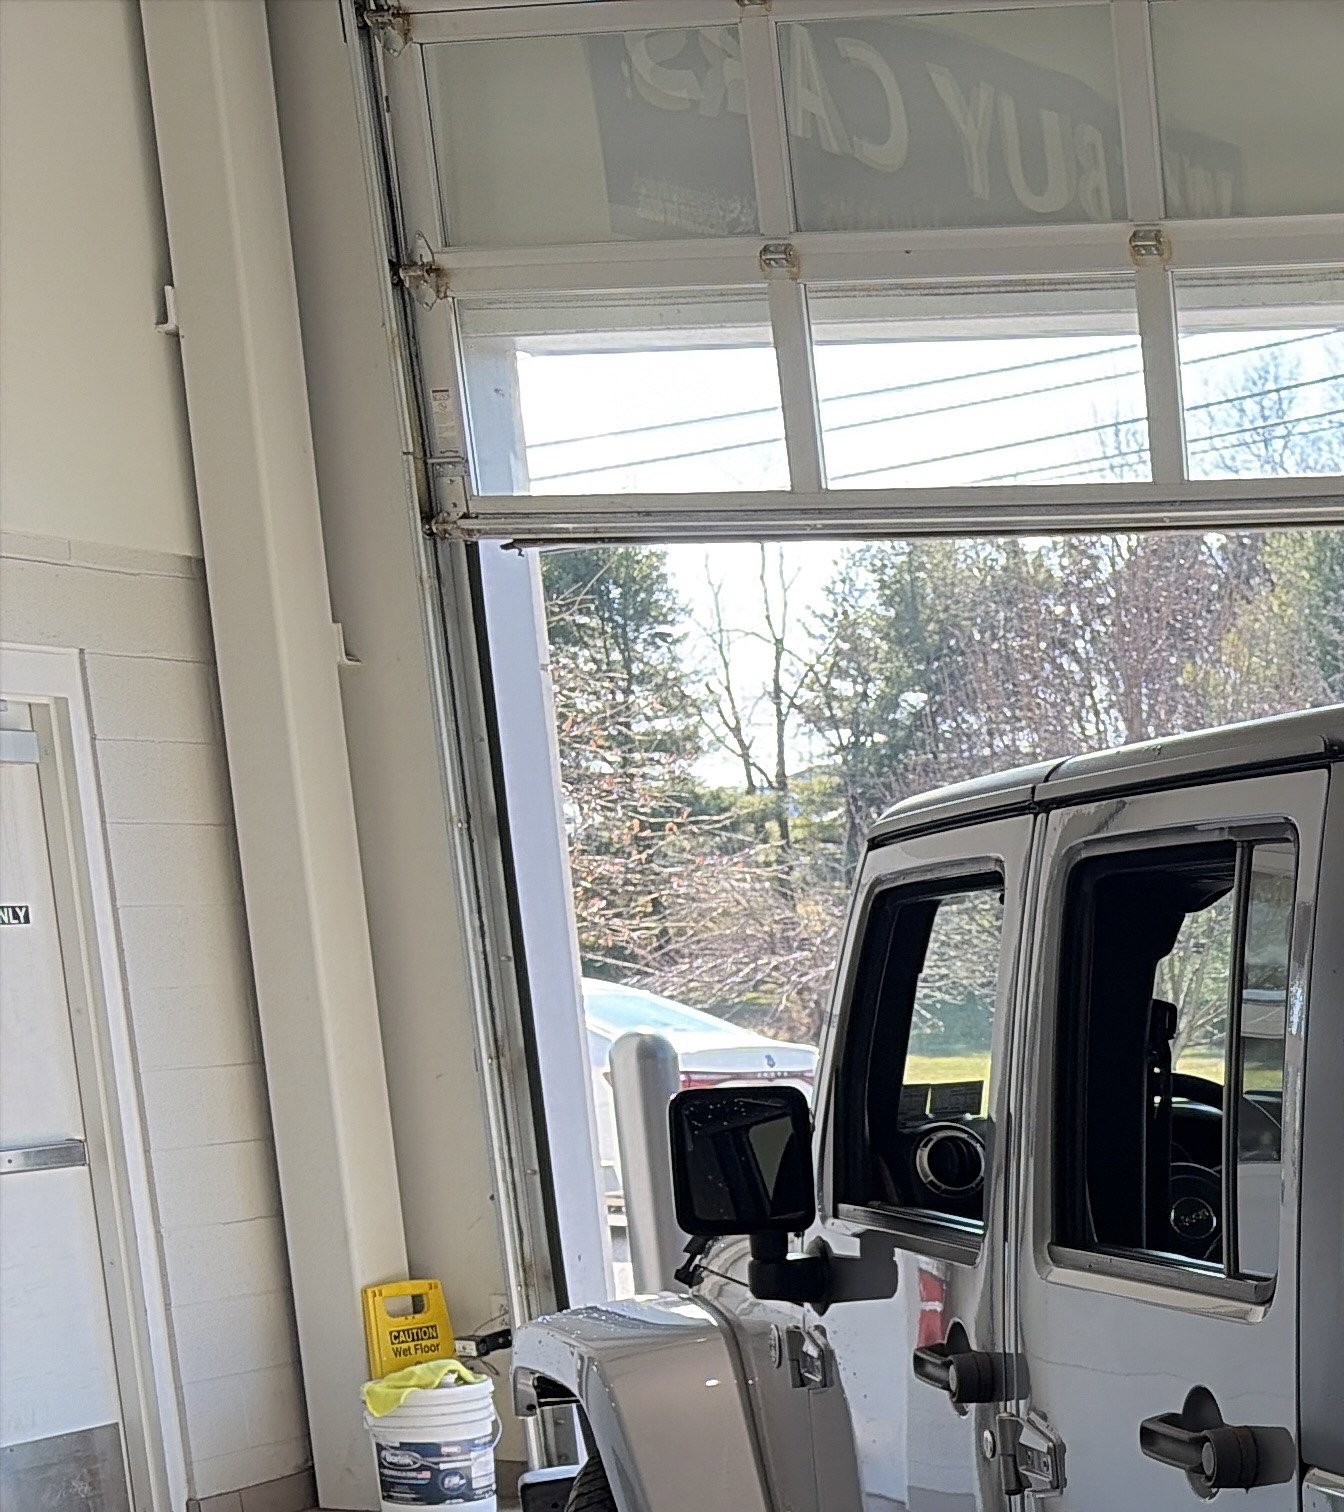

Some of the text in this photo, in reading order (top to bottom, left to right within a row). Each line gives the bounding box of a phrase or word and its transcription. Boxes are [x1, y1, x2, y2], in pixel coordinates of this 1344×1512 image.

[391, 1326, 438, 1344] CAUTION
[392, 1342, 440, 1358] Wet Floor
